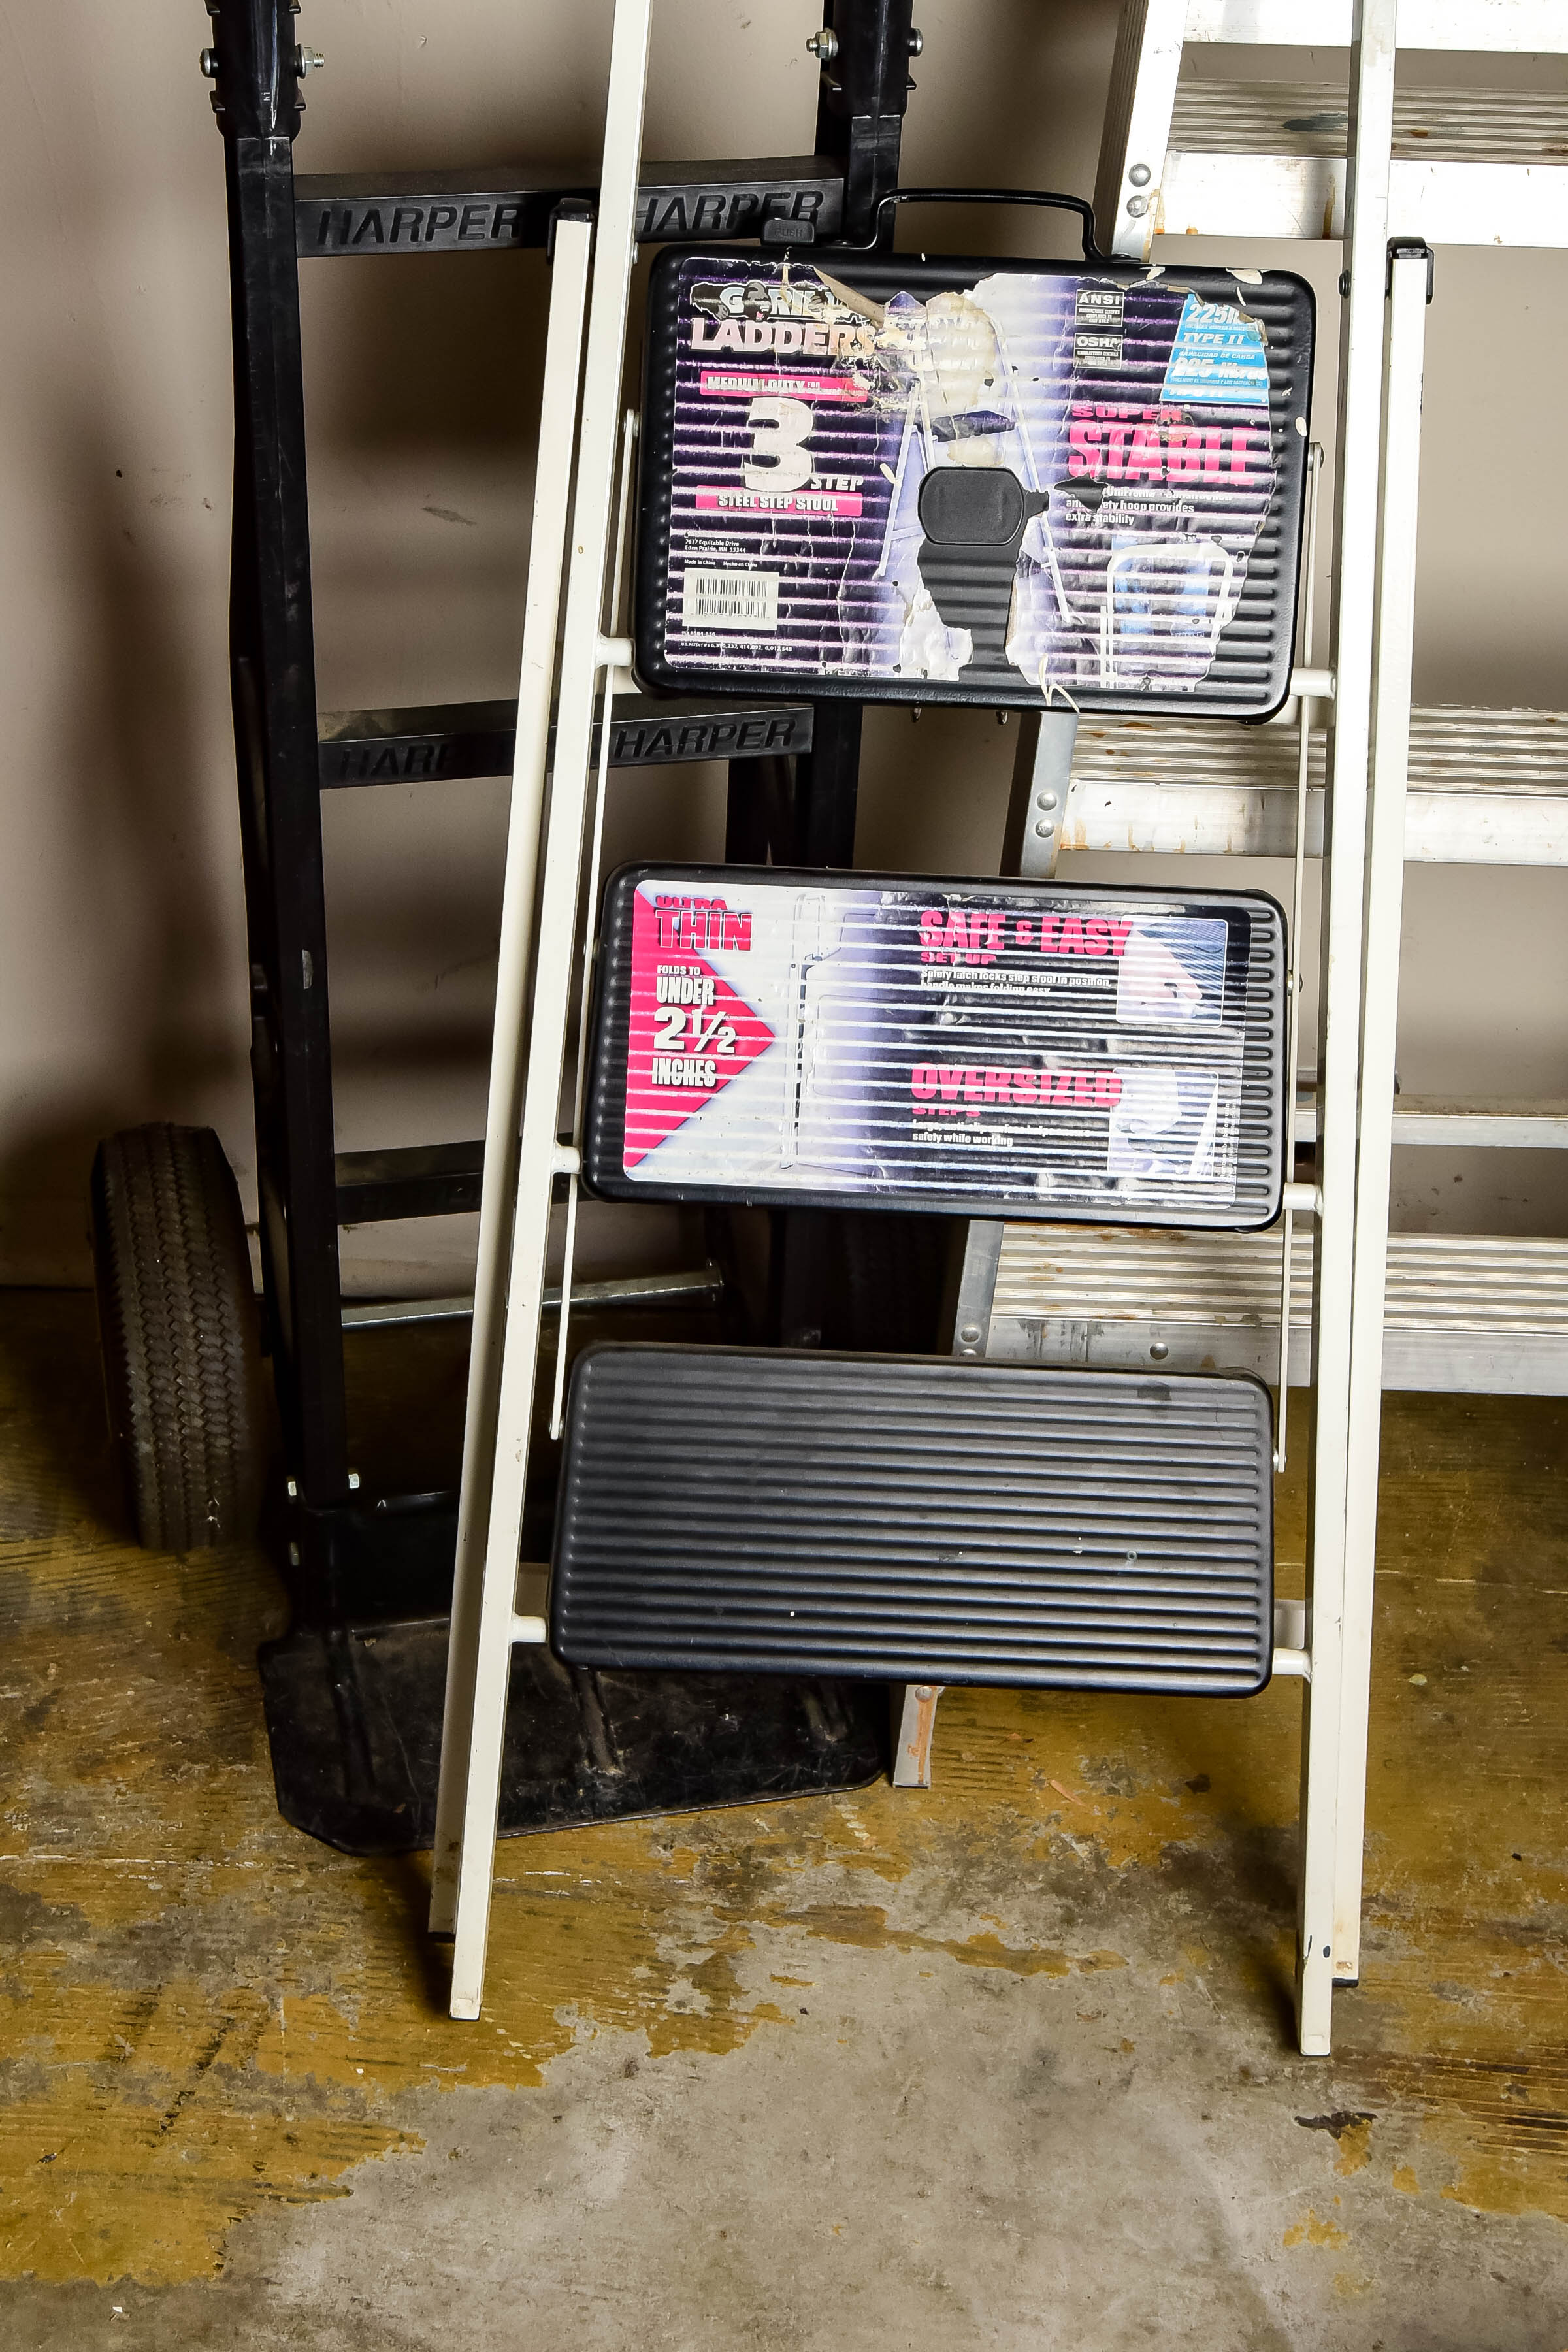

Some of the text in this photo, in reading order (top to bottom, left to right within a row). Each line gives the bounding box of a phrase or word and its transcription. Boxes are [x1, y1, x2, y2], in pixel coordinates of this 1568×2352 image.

[318, 203, 523, 246] HARPER
[774, 228, 803, 237] PUSH
[1078, 293, 1120, 305] ANSI
[691, 318, 877, 357] LADDERS
[1183, 332, 1225, 344] TYPE
[1072, 406, 1183, 421] SUPER
[742, 397, 813, 492] 3
[1068, 419, 1257, 486] STABLE
[811, 476, 864, 491] STEP
[719, 495, 838, 512] STEEL STEP STOOL
[1120, 500, 1147, 512] hoop
[1149, 501, 1194, 513] provides
[1065, 512, 1135, 526] extra stability
[614, 717, 796, 759] HARPER
[656, 896, 728, 910] ULTRA
[655, 909, 753, 952] THIN
[919, 911, 1133, 956] SAFE & EASY
[920, 951, 997, 965] SET UP
[657, 964, 701, 975] FOLDS TO
[1008, 973, 1030, 983] step
[1031, 973, 1056, 984] stool
[656, 976, 715, 1005] UNDER
[651, 1057, 716, 1087] INCHES
[911, 1061, 1122, 1107] OVERSIZED
[912, 1132, 1013, 1147] safety while working
